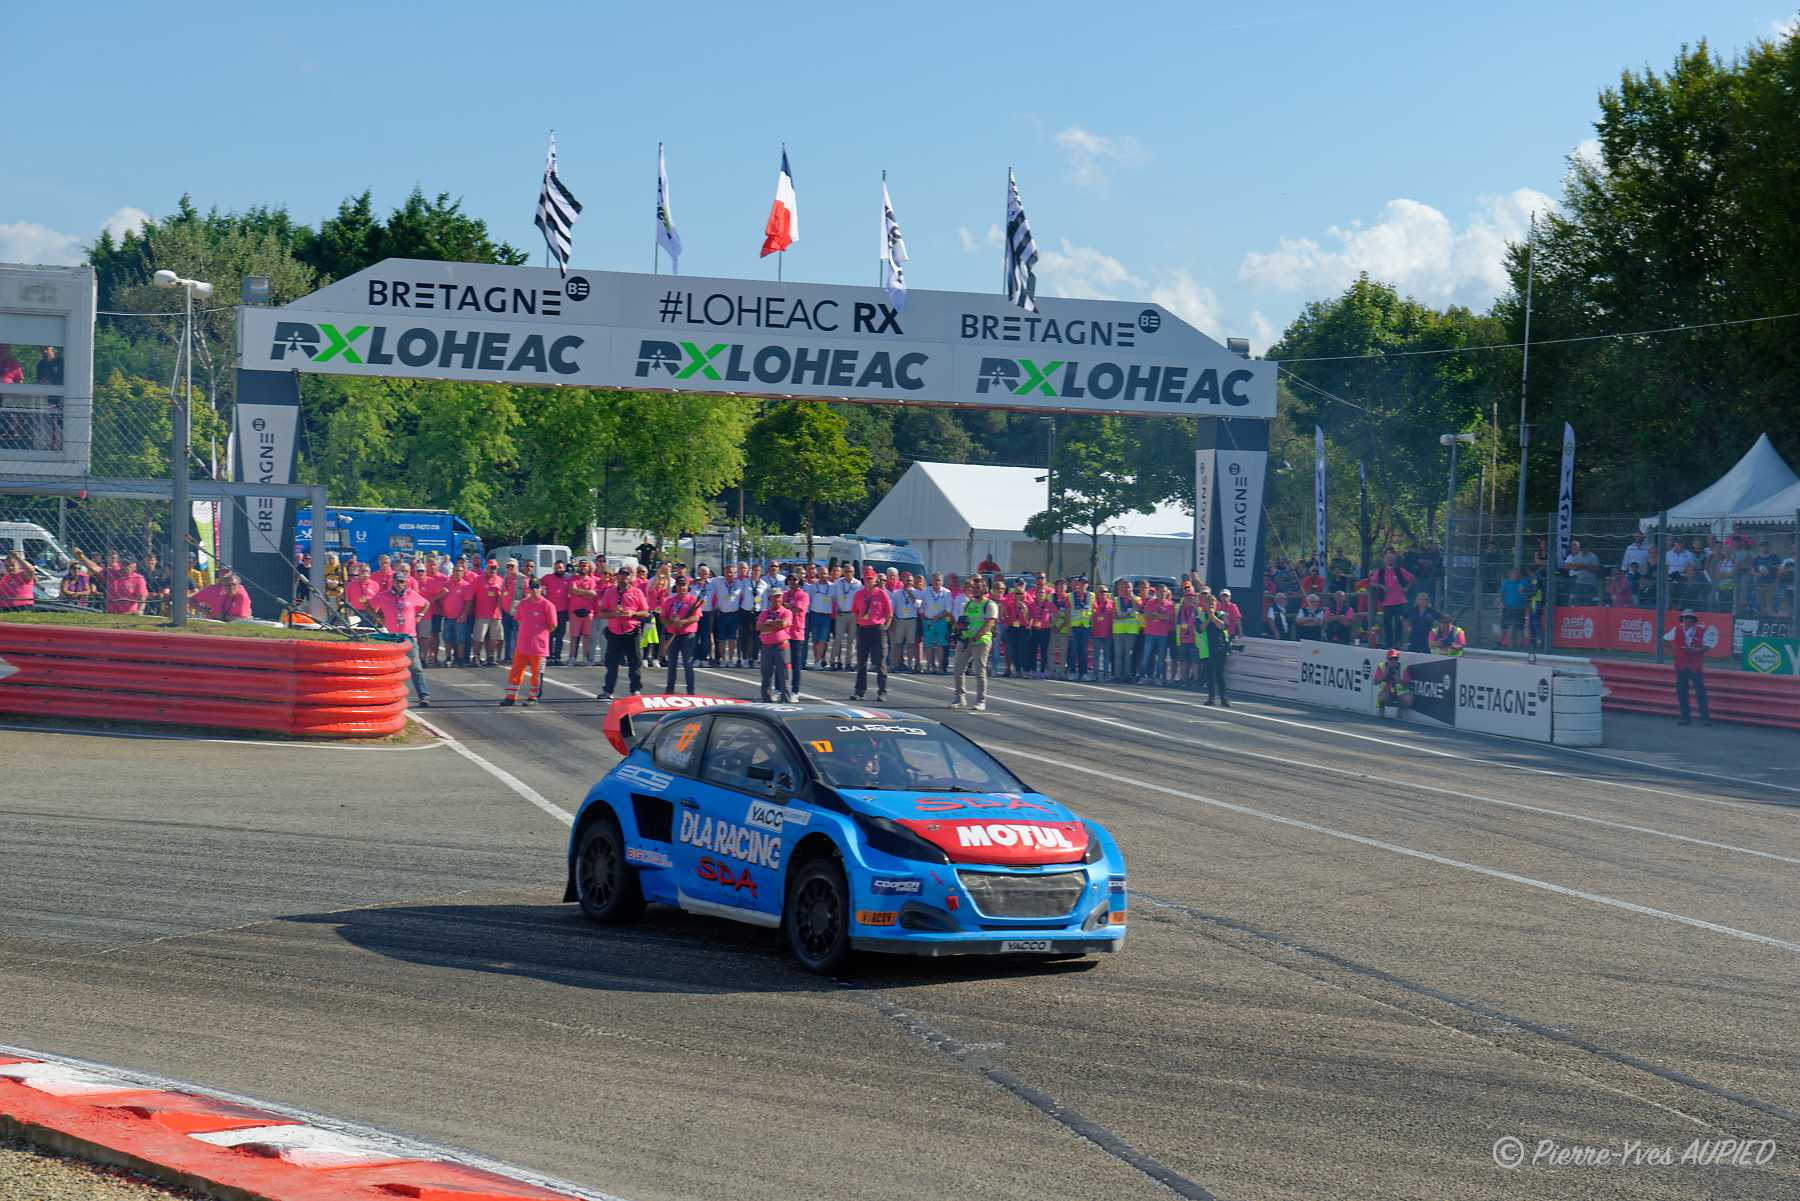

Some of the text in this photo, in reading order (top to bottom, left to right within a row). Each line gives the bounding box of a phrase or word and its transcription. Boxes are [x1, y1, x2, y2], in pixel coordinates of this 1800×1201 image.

[368, 279, 561, 316] BRETAGNE
[660, 290, 904, 335] #LOHEAC RX
[961, 313, 1135, 348] BRETAGNE
[1233, 476, 1248, 568] BRETAGNE
[1301, 661, 1362, 692] BRETAGNE
[1459, 684, 1537, 716] BRETAGNE
[810, 739, 833, 753] 17
[680, 810, 713, 851] DLA
[714, 820, 782, 871] RACING
[956, 824, 1073, 849] MOTUL
[697, 855, 758, 898] SDA
[1007, 941, 1047, 951] YACCO
